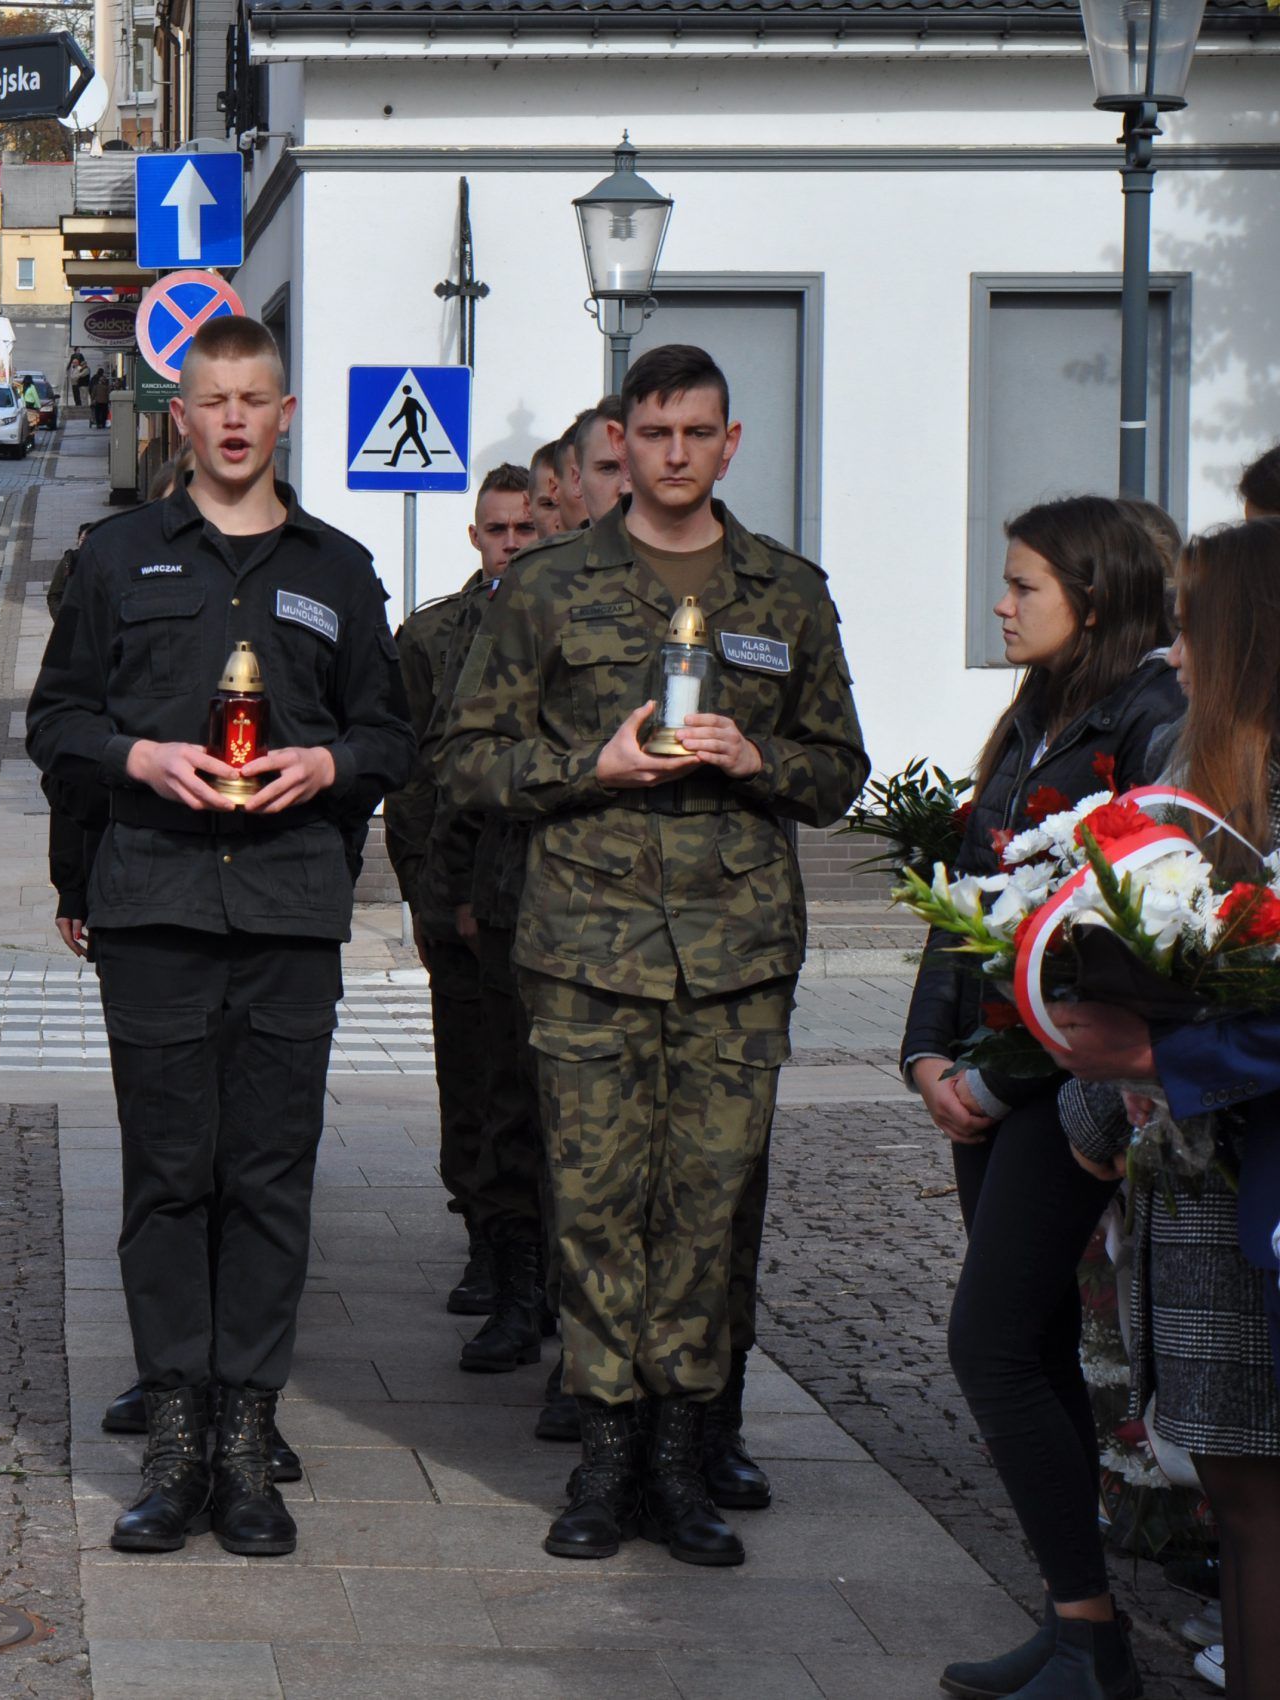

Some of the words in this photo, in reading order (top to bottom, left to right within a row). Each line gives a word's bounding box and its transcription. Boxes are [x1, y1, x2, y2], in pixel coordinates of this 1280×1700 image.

[141, 564, 183, 575] WARCZAK
[297, 600, 324, 617] KLASA
[282, 604, 335, 634] MUNDUROWA
[742, 640, 770, 653] KLASA
[728, 648, 785, 667] MUNDUROWA
